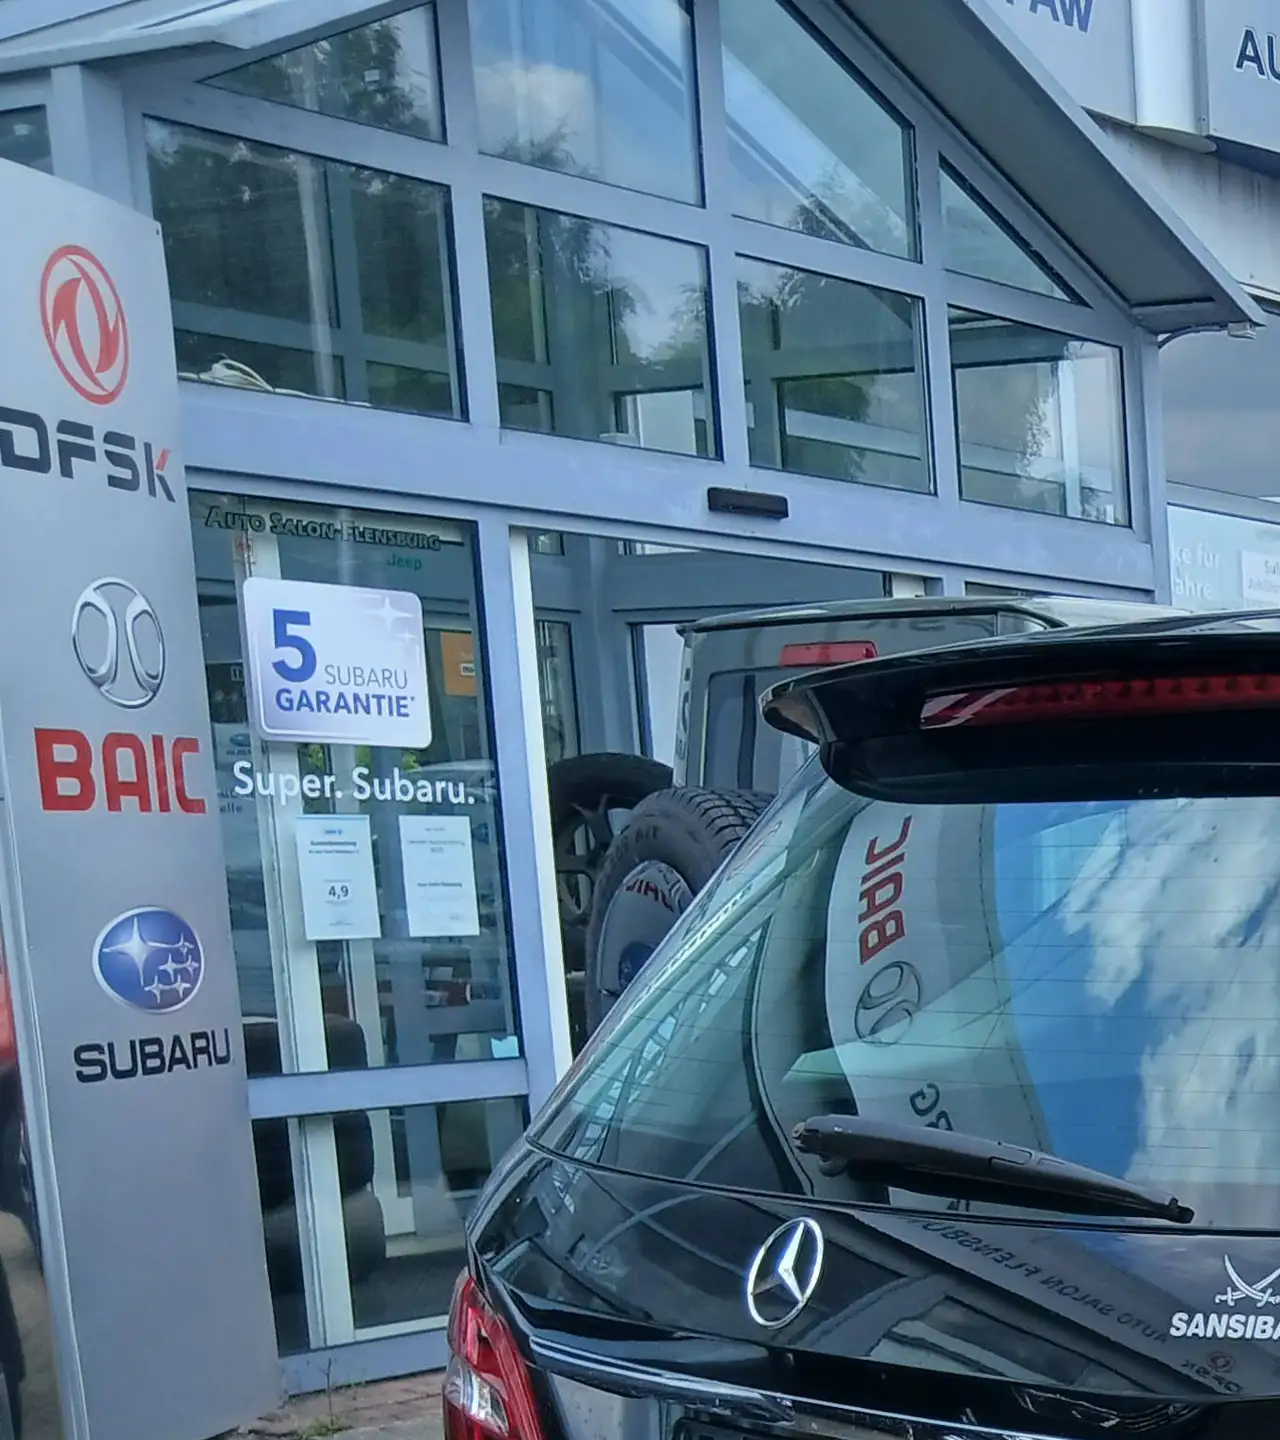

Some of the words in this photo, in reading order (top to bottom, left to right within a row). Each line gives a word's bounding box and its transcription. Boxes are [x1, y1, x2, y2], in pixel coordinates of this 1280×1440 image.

[0, 406, 176, 503] DFSK
[271, 608, 318, 683] 5
[324, 664, 408, 690] SUBARU
[34, 727, 207, 814] BAIC
[233, 760, 343, 806] Super.
[351, 766, 475, 805] Subaru.
[327, 884, 350, 900] 4,9
[73, 1028, 232, 1083] SUBARU
